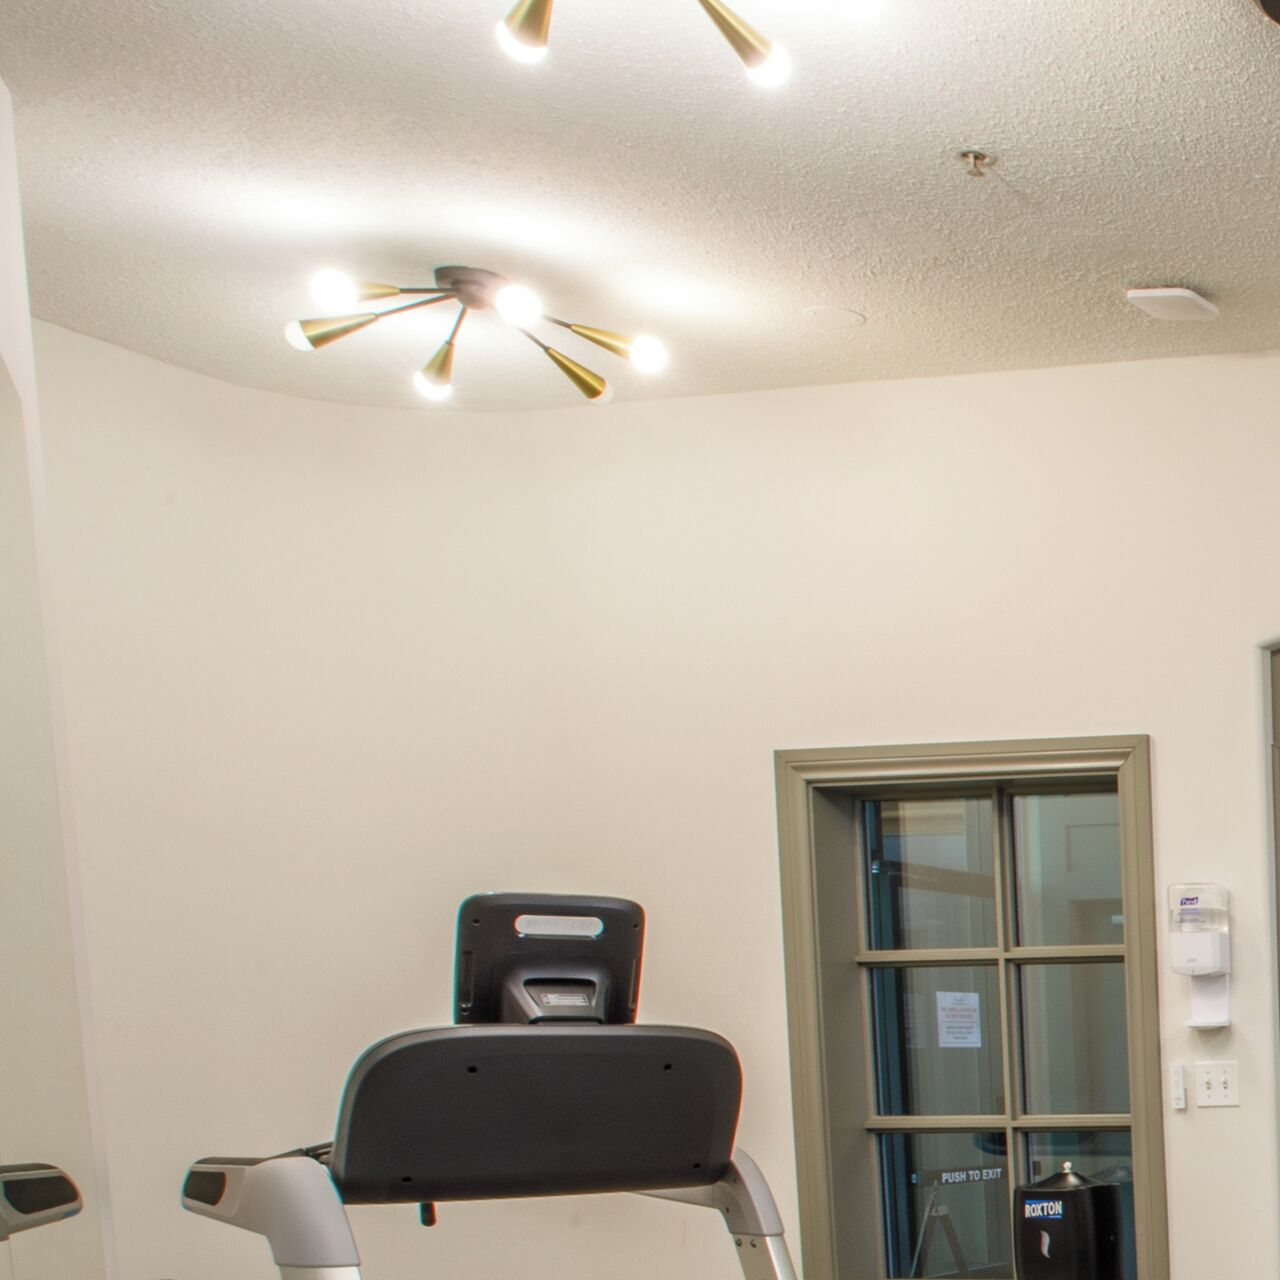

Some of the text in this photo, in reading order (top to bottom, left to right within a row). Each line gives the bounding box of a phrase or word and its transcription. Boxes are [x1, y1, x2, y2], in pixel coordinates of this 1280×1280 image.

[942, 1168, 1002, 1184] PUSH TO EXIT
[1025, 1200, 1062, 1218] ROXTON
